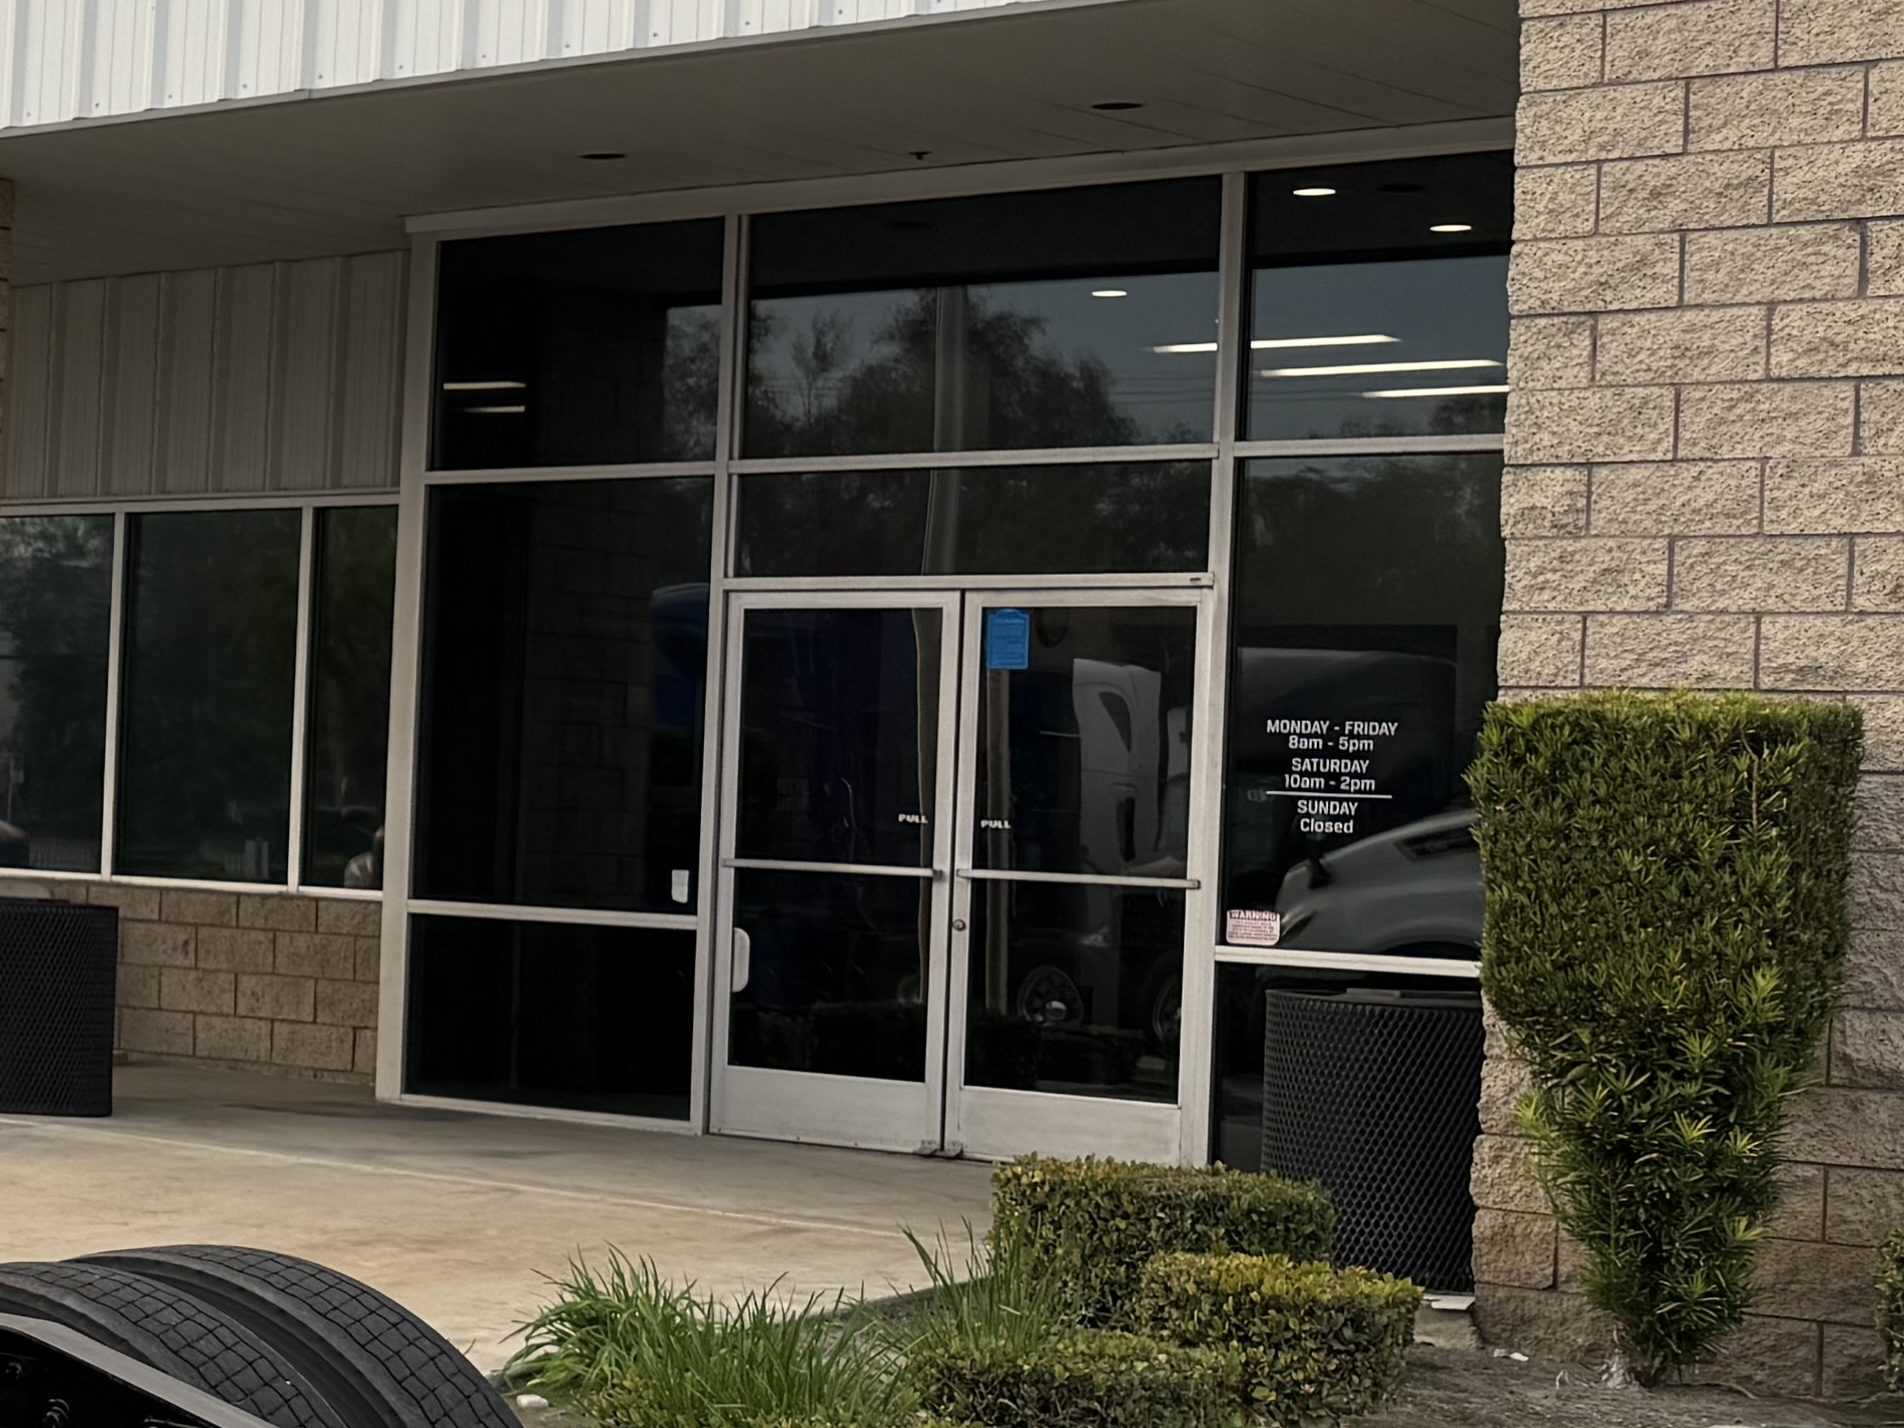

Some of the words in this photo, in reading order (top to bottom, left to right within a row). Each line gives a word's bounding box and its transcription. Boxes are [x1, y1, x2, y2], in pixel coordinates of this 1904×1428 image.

[1266, 719, 1330, 734] MONDAY
[1344, 721, 1399, 736] FRIDAY
[1288, 735, 1323, 750] 8am
[1338, 736, 1374, 753] 5pm
[1291, 757, 1370, 774] SATURDAY
[1284, 773, 1325, 789] 10am
[1339, 776, 1376, 793] 2pm
[1297, 799, 1359, 816] SUNDAY
[898, 813, 928, 824] PULL
[980, 819, 1011, 829] PULL
[1300, 818, 1354, 834] Closed
